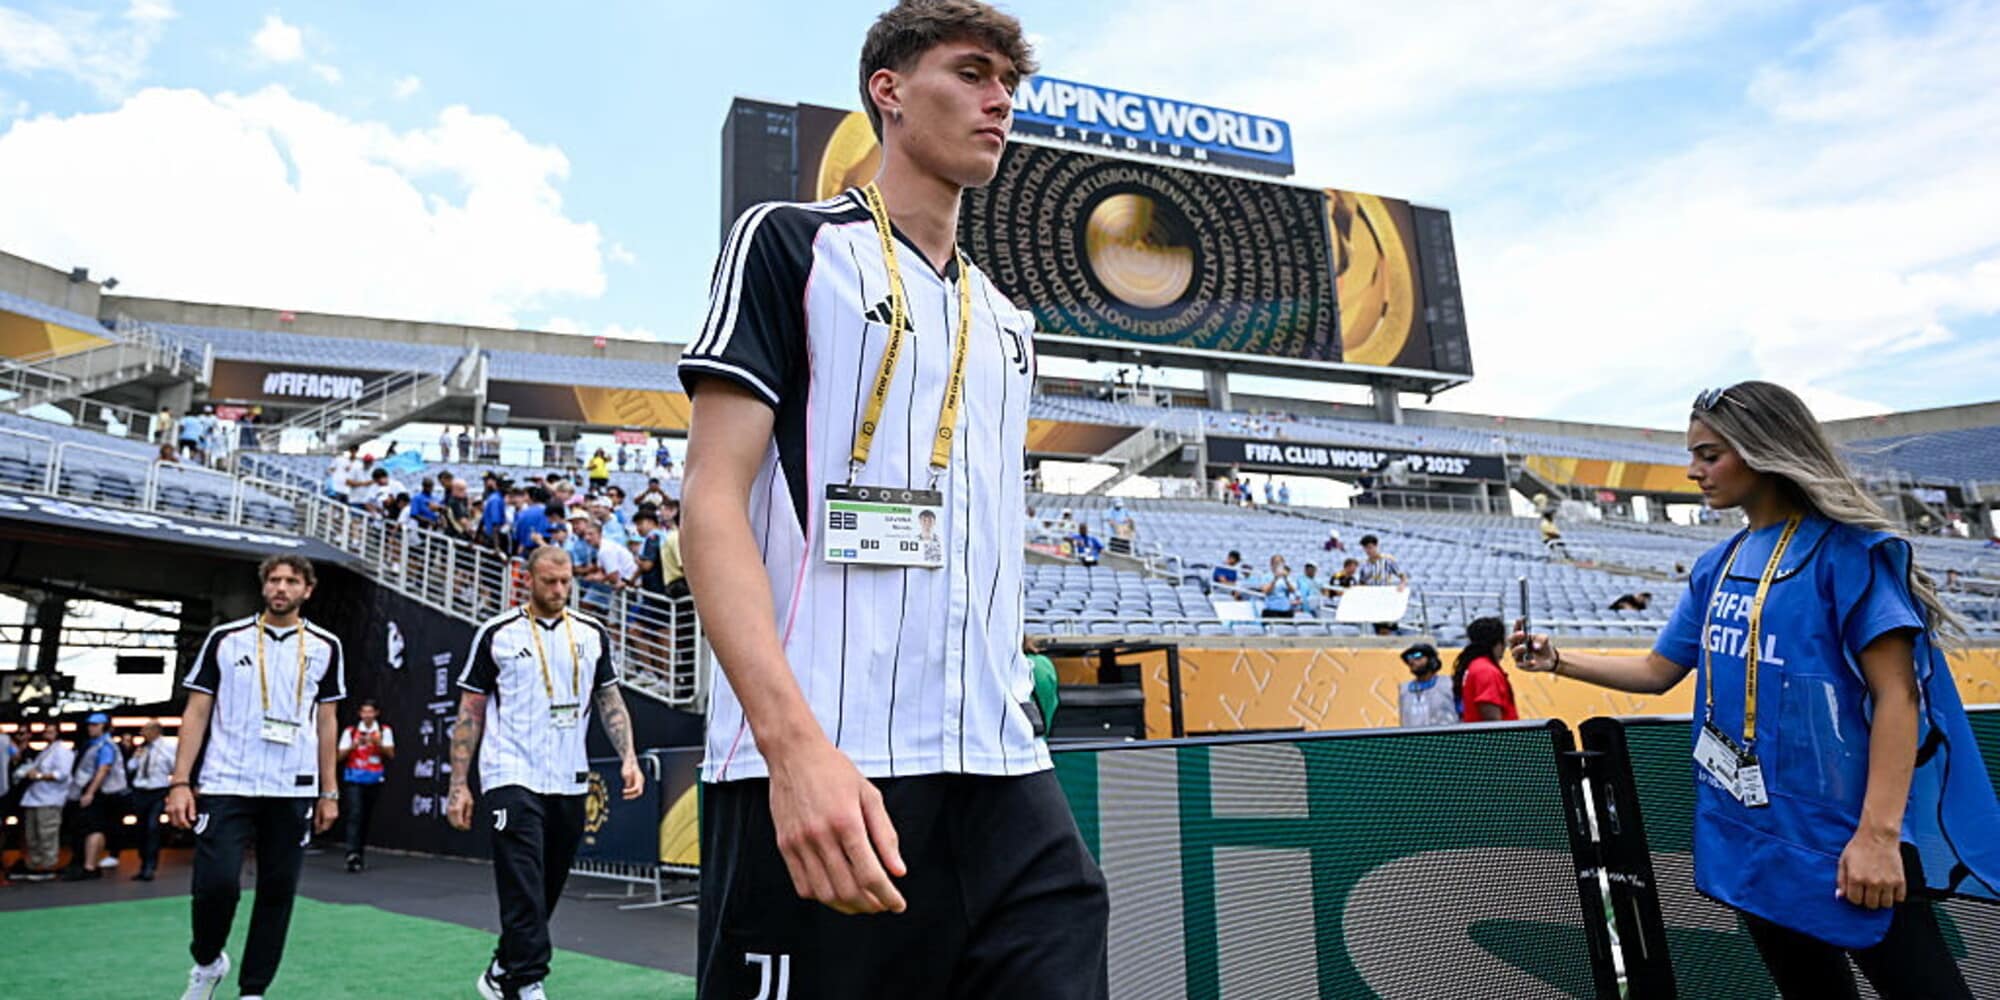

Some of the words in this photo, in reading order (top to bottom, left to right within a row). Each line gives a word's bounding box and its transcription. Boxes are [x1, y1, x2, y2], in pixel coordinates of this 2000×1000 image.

[1012, 79, 1146, 131] MPING
[1148, 99, 1284, 153] WORLD
[1055, 125, 1208, 161] STADIUM
[1016, 151, 1059, 225] FOOTBALL
[1037, 170, 1074, 246] ESPORTIVA
[1061, 179, 1093, 222] SPORT
[1090, 168, 1140, 189] LISBOA
[995, 242, 1018, 285] CLUB
[1016, 228, 1064, 327] SUNDOWNS
[1059, 228, 1079, 271] CLUB
[1199, 233, 1218, 300] SEATTLE
[1230, 219, 1256, 303] JUVENTUS
[1260, 249, 1275, 302] PORTO
[1040, 250, 1097, 333] SOCIEDADE
[1071, 271, 1139, 333] FOOTBALL
[1140, 297, 1208, 335] SOUNDERS
[263, 371, 364, 400] #FIFACWC
[1244, 443, 1284, 463] FIFA
[1285, 446, 1329, 466] CLUB
